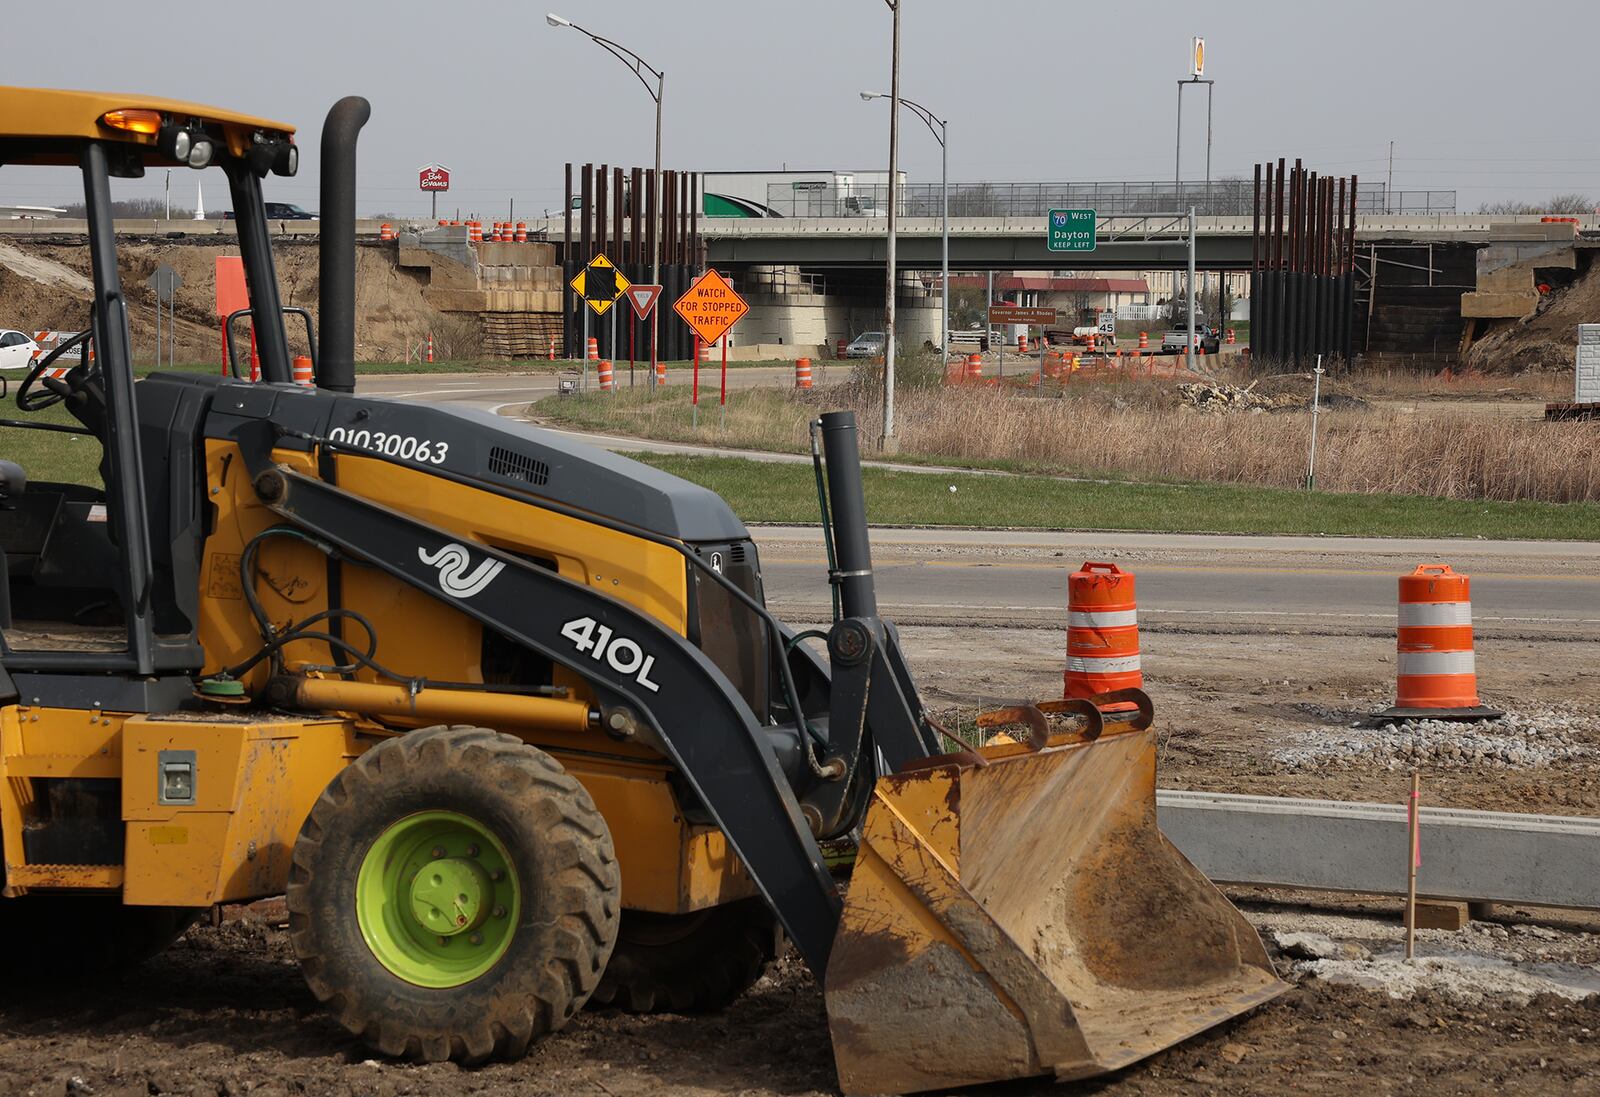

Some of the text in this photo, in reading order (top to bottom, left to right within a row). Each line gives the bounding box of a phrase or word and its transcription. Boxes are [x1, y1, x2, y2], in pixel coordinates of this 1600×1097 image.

[421, 179, 448, 187] Evans
[1055, 216, 1066, 224] 70
[1055, 231, 1090, 240] Dayton
[698, 289, 726, 298] WATCH
[680, 302, 742, 312] FOR STOPPED
[693, 316, 729, 326] TRAFFIC
[1100, 324, 1113, 332] 45
[329, 427, 449, 464] 01030063
[561, 617, 660, 693] 410L
